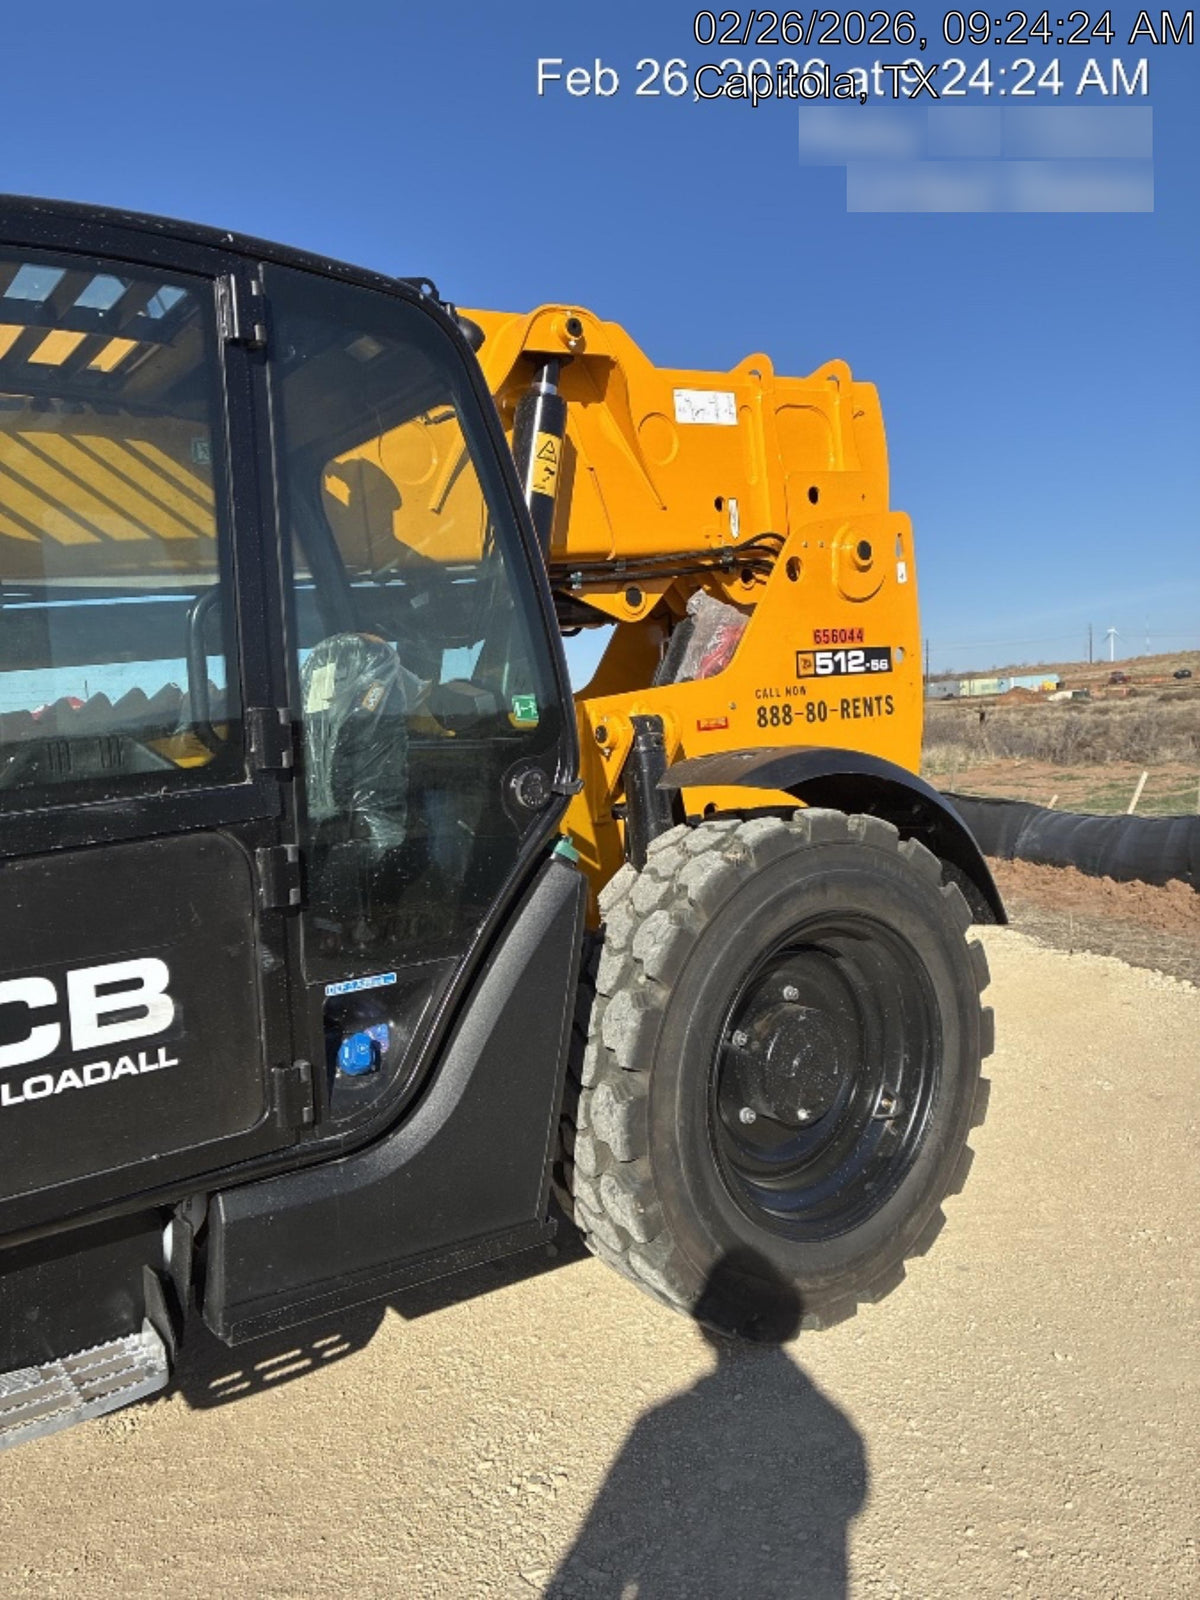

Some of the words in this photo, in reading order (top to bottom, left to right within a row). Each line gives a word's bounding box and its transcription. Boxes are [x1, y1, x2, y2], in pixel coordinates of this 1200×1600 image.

[813, 627, 864, 645] 656044
[755, 688, 781, 700] CALL
[756, 694, 895, 728] 888-80-RENTS
[0, 1046, 180, 1107] LOADALL
